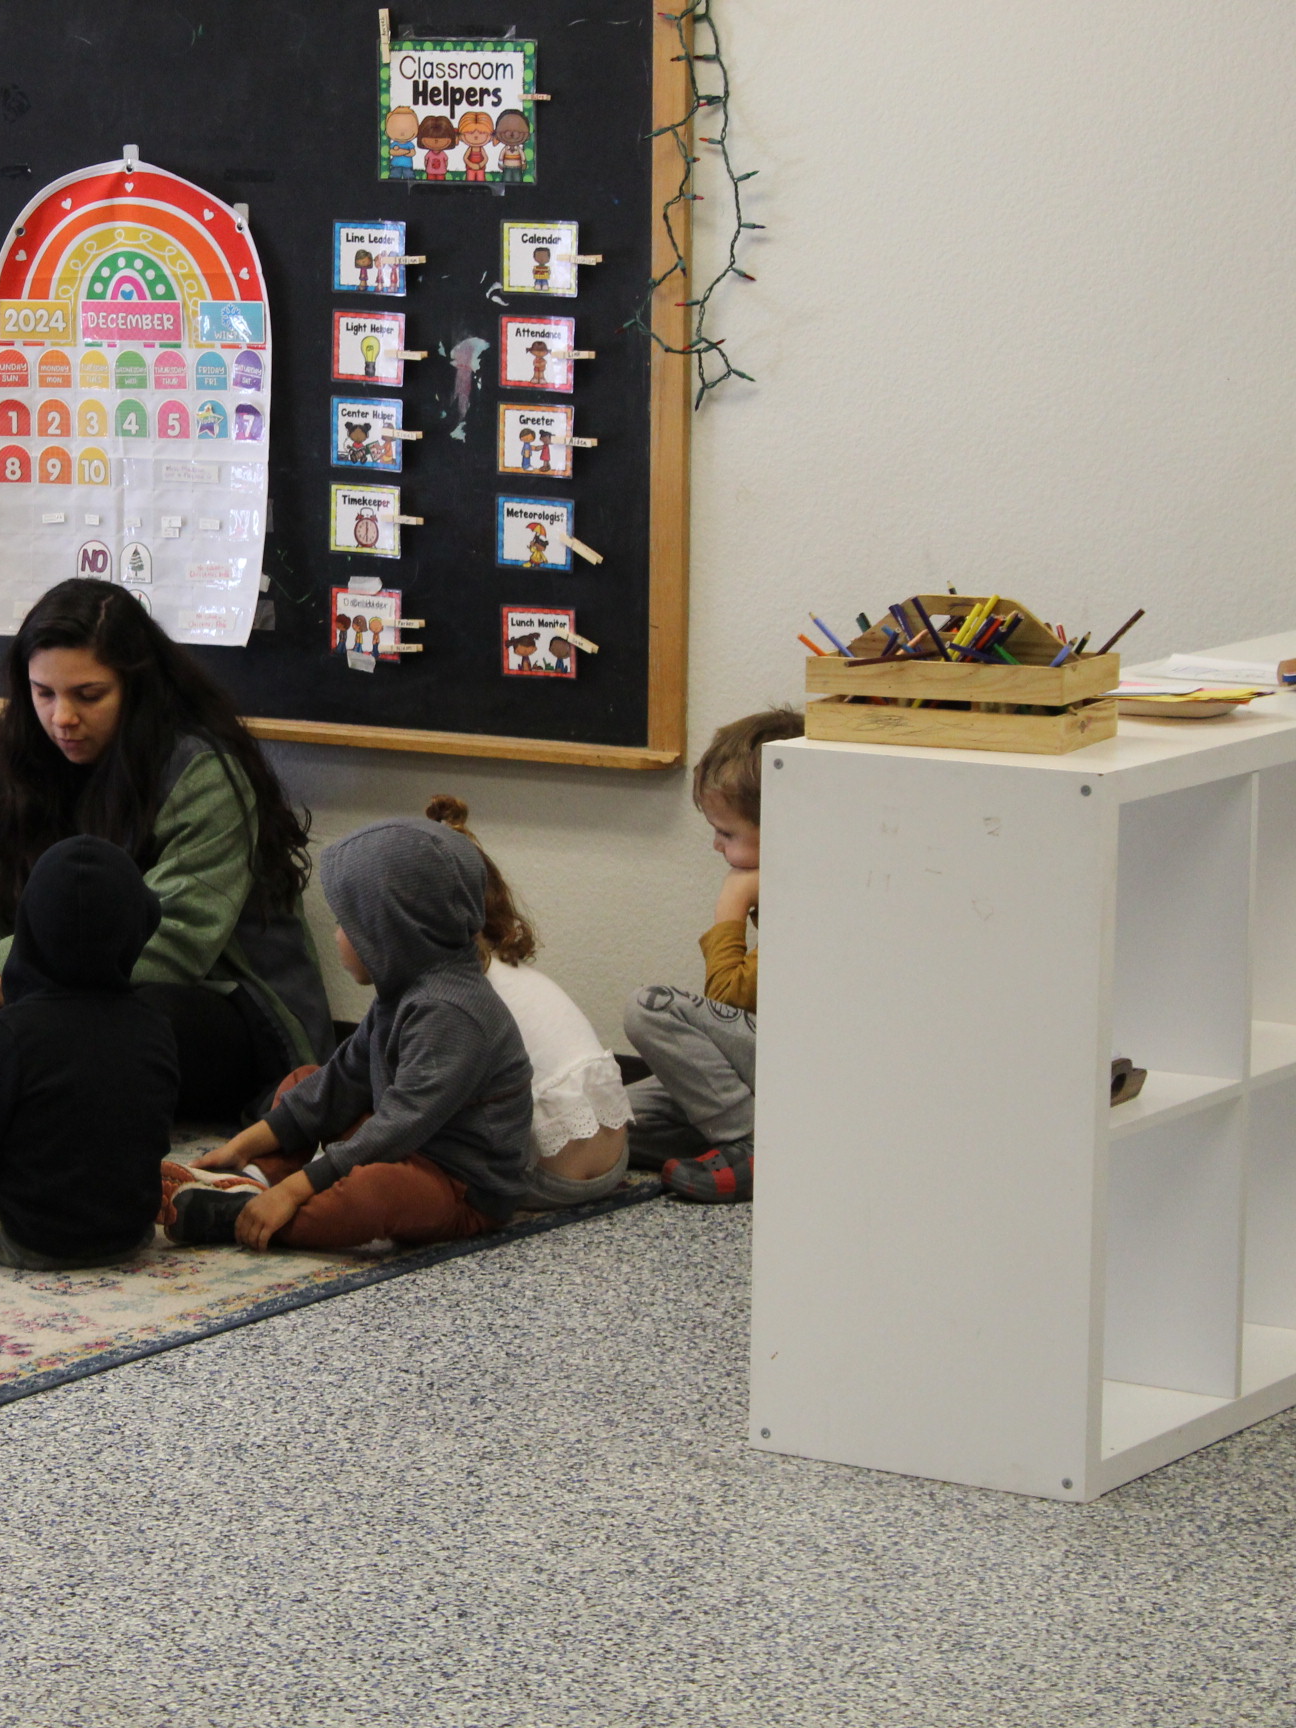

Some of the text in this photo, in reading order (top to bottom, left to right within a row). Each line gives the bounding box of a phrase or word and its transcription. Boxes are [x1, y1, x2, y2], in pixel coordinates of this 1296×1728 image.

[399, 55, 514, 81] Classroom
[412, 80, 503, 119] Helpers
[345, 232, 395, 244] Line Leader
[521, 233, 561, 245] Calendar
[4, 308, 67, 332] 2024
[87, 311, 174, 331] DECEMBER
[346, 322, 394, 338] Light Helper
[515, 328, 561, 340] Attendance
[198, 366, 225, 375] FRIDAY
[7, 411, 18, 434] 1
[47, 411, 61, 435] 2
[86, 411, 99, 435] 3
[123, 412, 140, 435] 4
[167, 413, 180, 436] 5
[243, 414, 255, 437] 7
[341, 408, 394, 422] Center Helper
[519, 414, 555, 426] Greeter
[5, 457, 22, 480] 8
[46, 458, 62, 481] 9
[81, 459, 106, 483] 10
[342, 495, 390, 511] Timekeeper
[506, 507, 564, 525] Meteorologist
[80, 548, 108, 573] NO
[511, 618, 567, 629] Lunch Monitor
